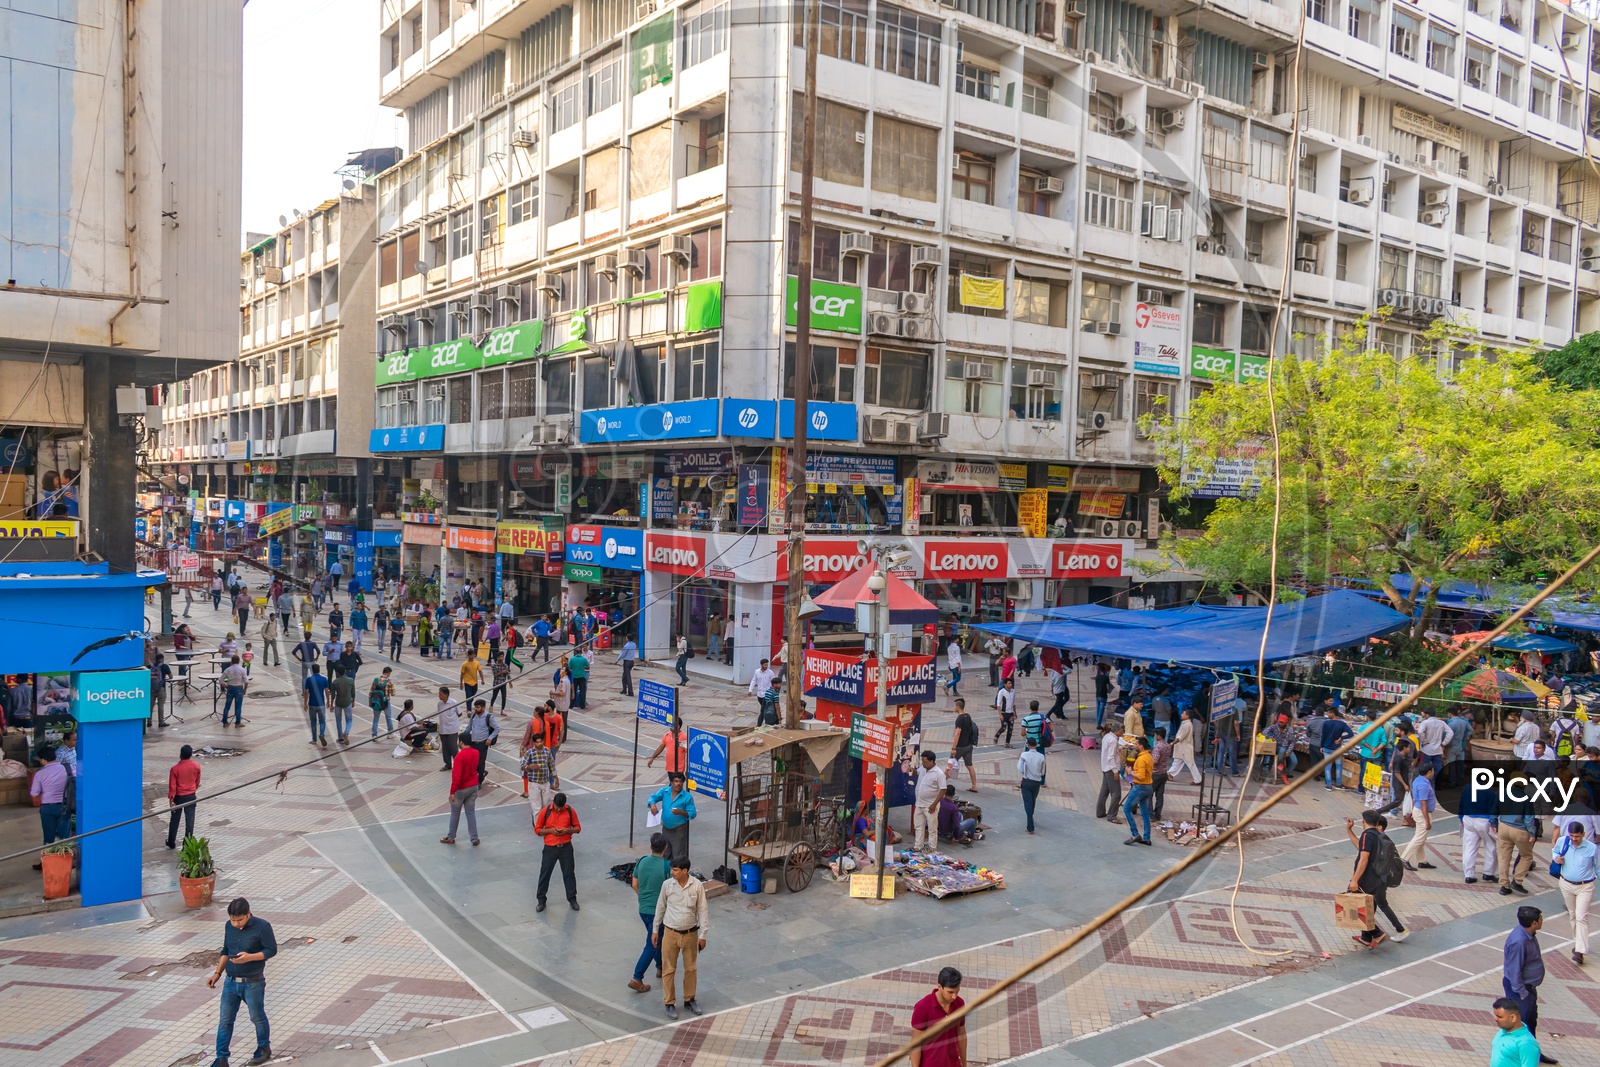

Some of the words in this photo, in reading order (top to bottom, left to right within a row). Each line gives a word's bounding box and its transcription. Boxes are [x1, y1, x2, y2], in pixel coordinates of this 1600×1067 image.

[794, 294, 854, 317] cer
[1152, 308, 1180, 322] Gseven
[483, 329, 520, 358] acer
[1158, 344, 1178, 360] Tally
[388, 352, 413, 376] acer
[431, 342, 462, 368] acer
[1193, 354, 1231, 374] acer
[597, 417, 607, 435] hp
[608, 420, 621, 429] WORLD
[662, 411, 673, 431] hp
[675, 415, 691, 424] WORLD
[739, 407, 758, 428] hp
[812, 410, 828, 430] hp
[843, 457, 894, 465] REPAIRING
[954, 464, 997, 475] HIKVISION
[1076, 475, 1092, 485] Repair
[654, 491, 673, 500] LAPTOP
[325, 530, 342, 541] SAMSUNG
[498, 537, 510, 546] MOBILE
[572, 548, 593, 560] vivo
[648, 541, 699, 567] Lenovo
[787, 553, 868, 572] enovo
[931, 552, 998, 571] Lenovo
[571, 569, 593, 577] oppo
[806, 657, 834, 674] NEHRU
[836, 662, 862, 680] PLACE
[867, 666, 898, 682] NERU
[902, 664, 934, 680] PLACE
[810, 676, 822, 686] P.S.
[825, 678, 857, 694] KALKAJI
[891, 684, 926, 696] KALKAJI
[87, 688, 145, 705] logitech
[659, 697, 669, 708] UNDER
[658, 708, 667, 717] STAY
